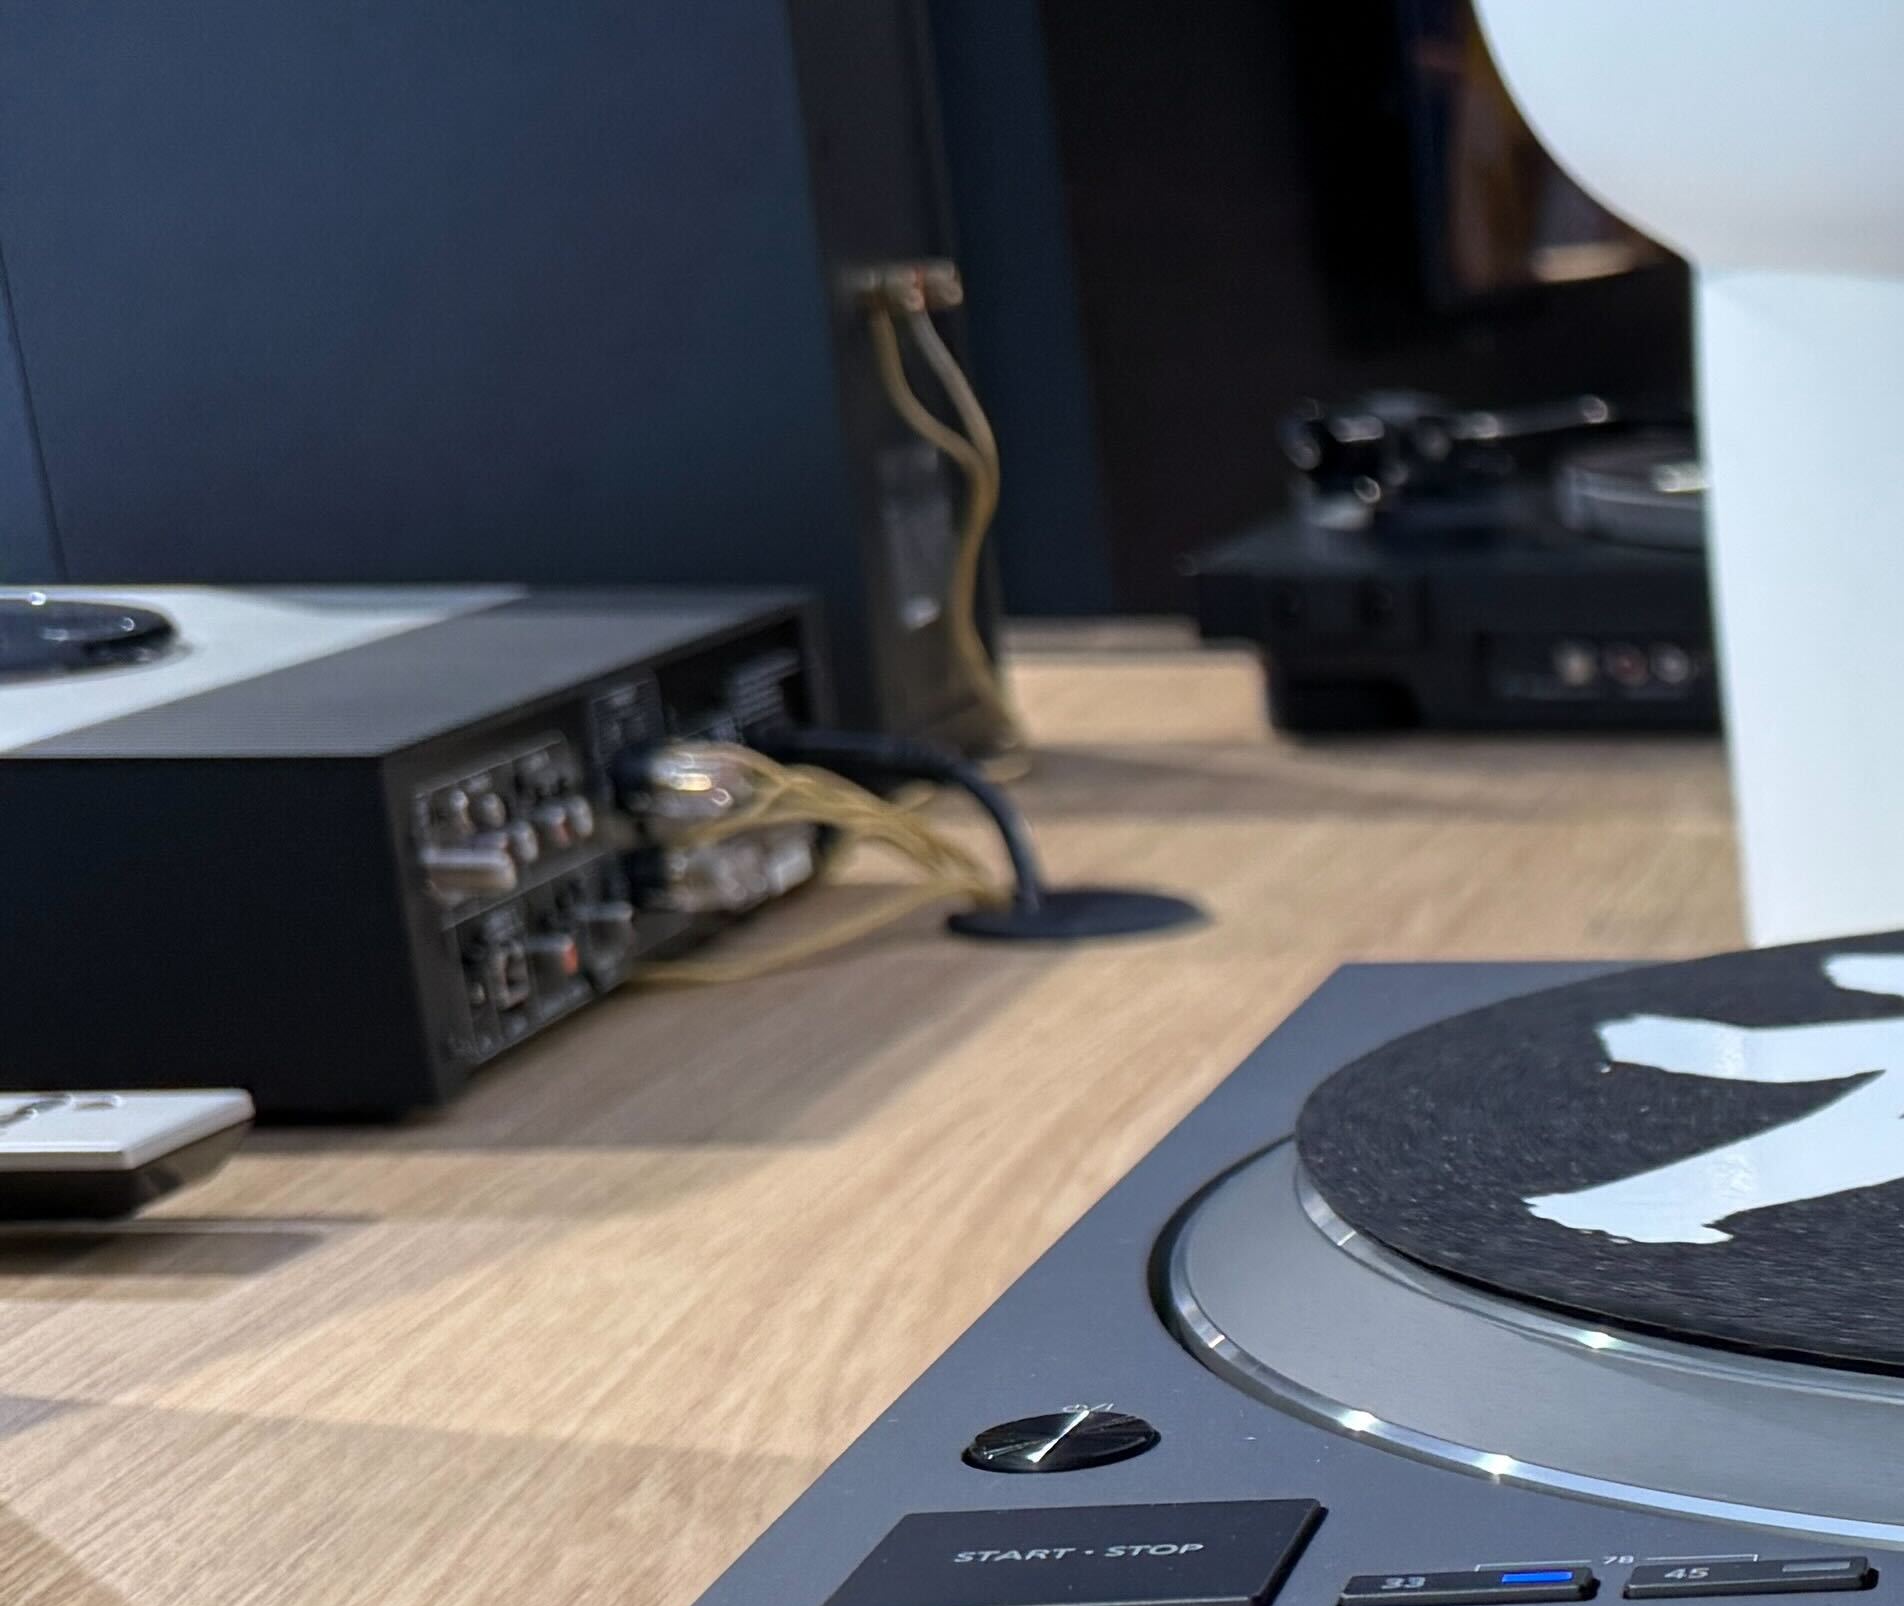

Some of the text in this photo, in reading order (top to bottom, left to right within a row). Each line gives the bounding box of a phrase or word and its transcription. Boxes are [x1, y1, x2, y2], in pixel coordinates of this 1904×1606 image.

[953, 1547, 1076, 1563] START
[1104, 1543, 1204, 1557] STOP
[1602, 1555, 1635, 1566] 78
[1663, 1566, 1710, 1580] 45
[1381, 1576, 1426, 1590] 33
